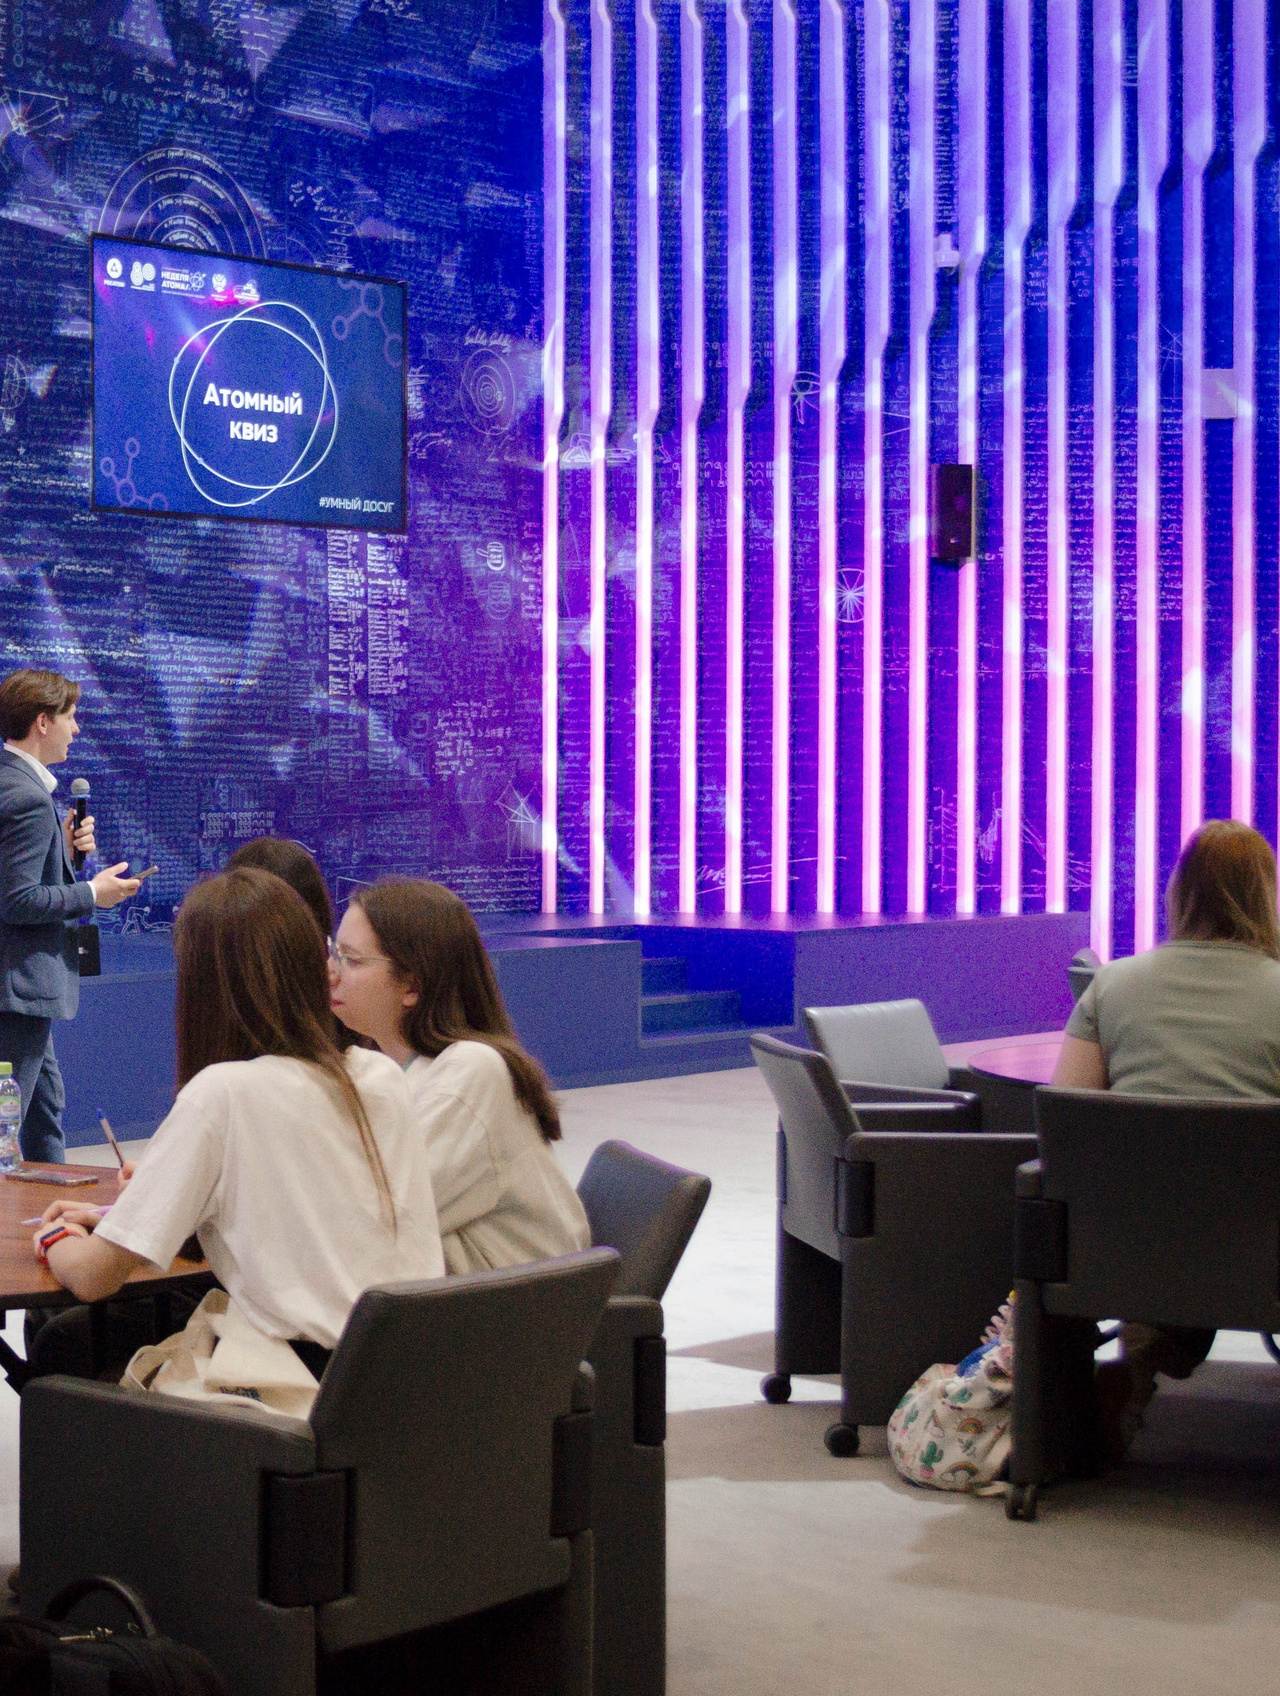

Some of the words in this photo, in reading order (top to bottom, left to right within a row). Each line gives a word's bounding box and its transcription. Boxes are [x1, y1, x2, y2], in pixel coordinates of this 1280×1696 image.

[161, 271, 190, 282] НЕДЕЛЯ
[319, 497, 362, 511] #УМНЫЙ
[363, 500, 395, 513] ДОСУГ
